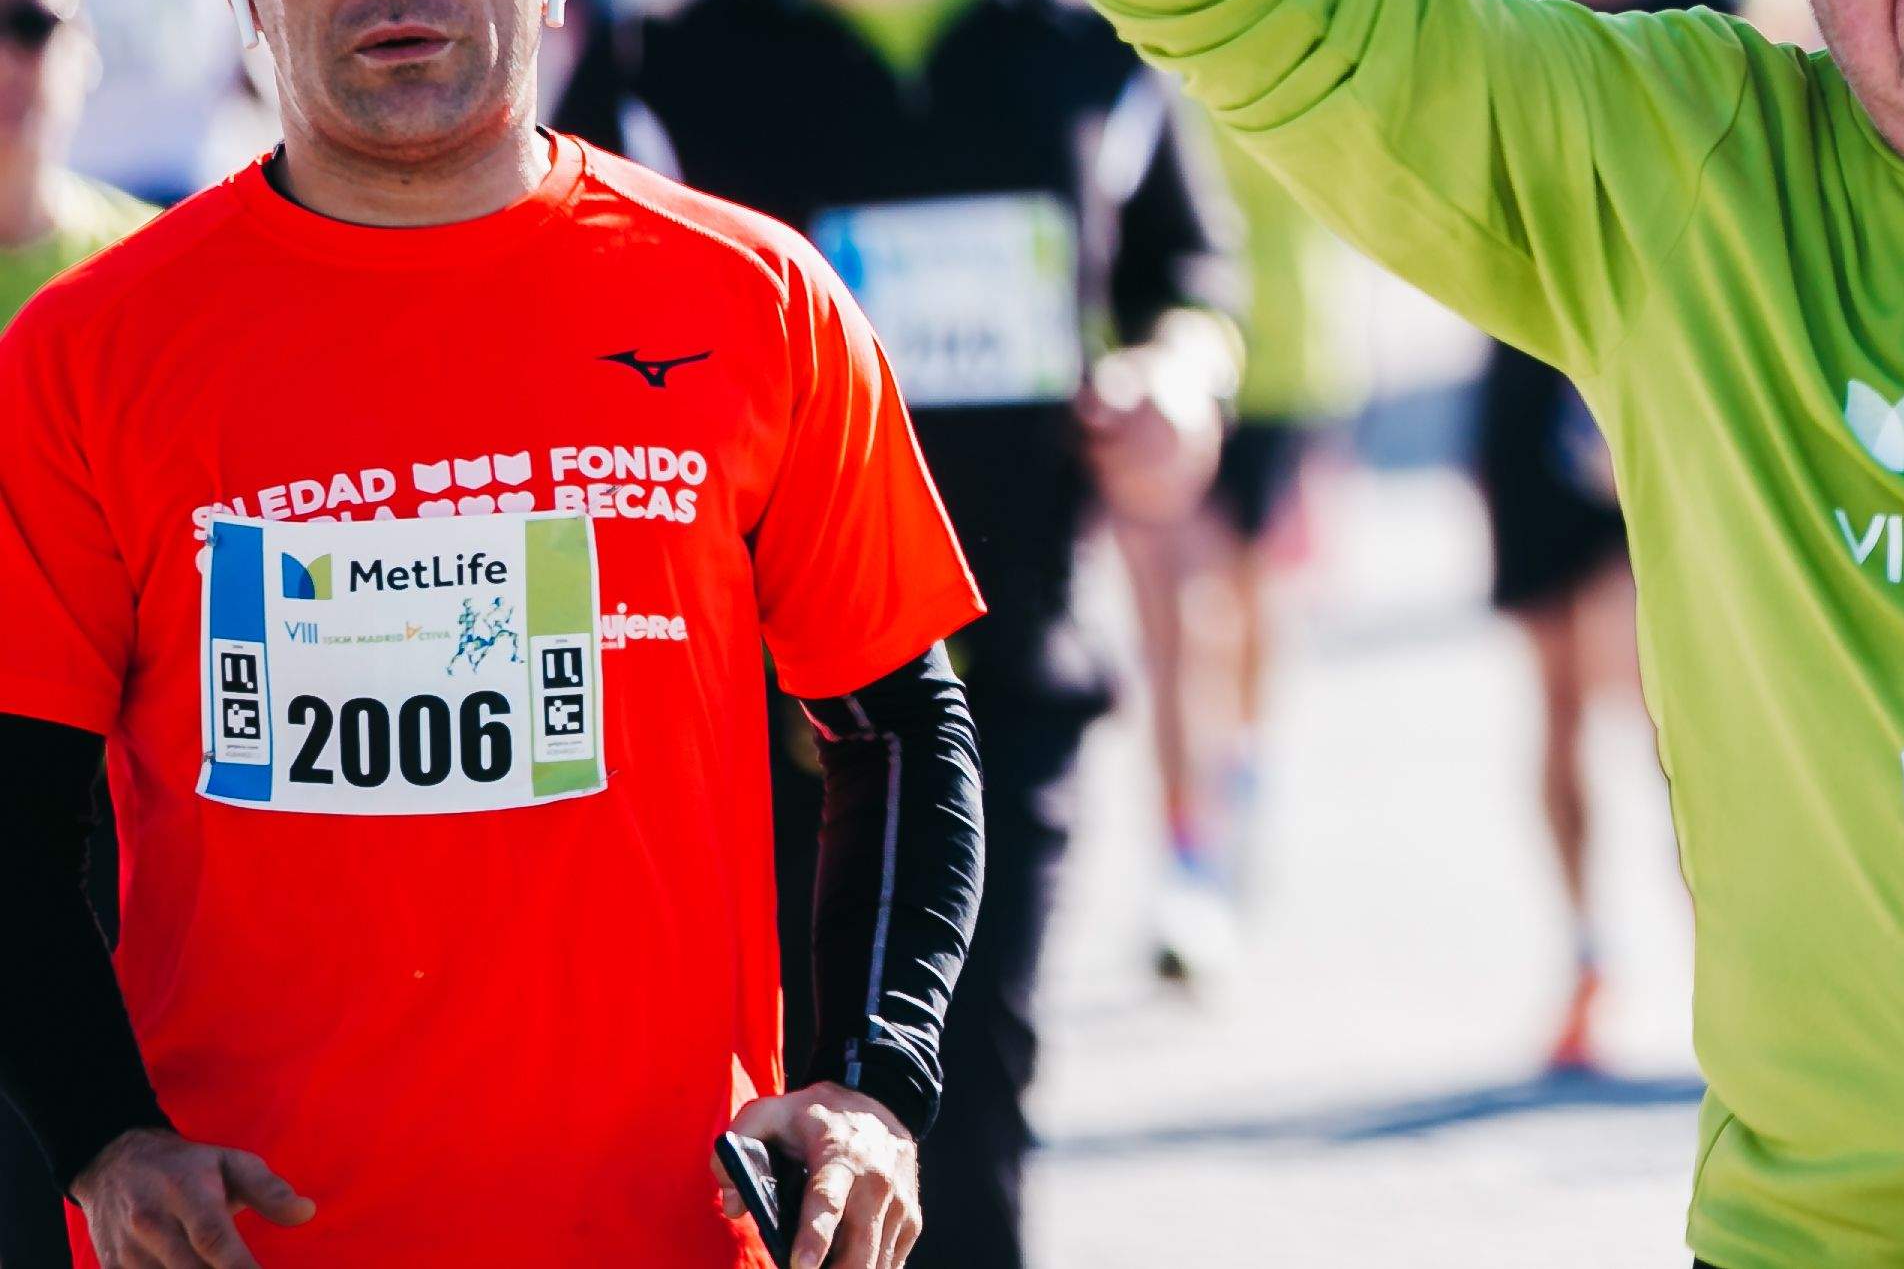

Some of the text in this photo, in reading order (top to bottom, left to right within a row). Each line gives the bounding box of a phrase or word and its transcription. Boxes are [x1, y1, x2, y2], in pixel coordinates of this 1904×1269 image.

[550, 445, 708, 486] FONDO
[554, 482, 698, 524] BECAS
[349, 552, 508, 592] MetLife
[284, 620, 319, 645] VIII
[288, 690, 513, 788] 2006
